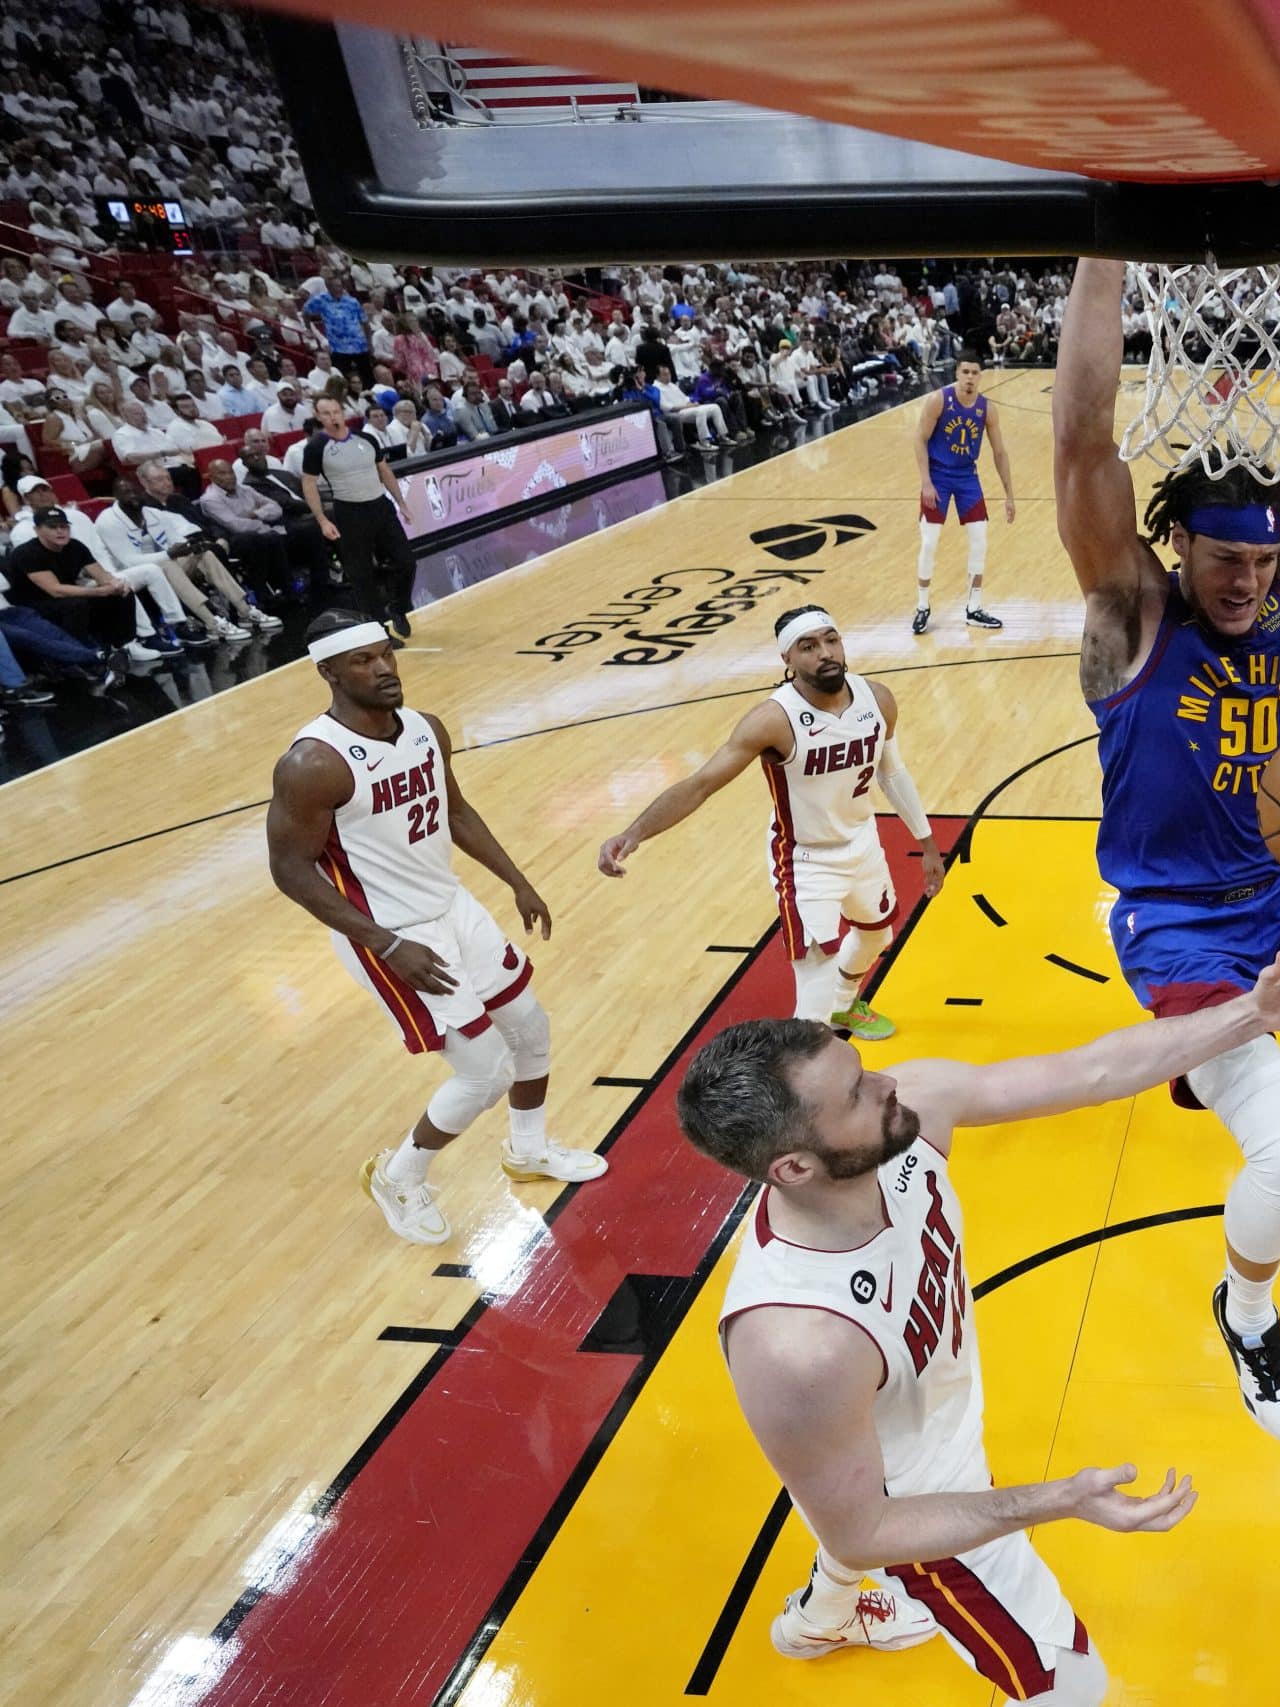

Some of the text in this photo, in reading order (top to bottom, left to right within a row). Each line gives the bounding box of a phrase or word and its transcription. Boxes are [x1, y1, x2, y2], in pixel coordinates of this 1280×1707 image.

[960, 428, 966, 446] 1
[515, 567, 736, 662] Center
[600, 568, 827, 666] Kaseya
[857, 711, 874, 722] UKG
[1176, 656, 1242, 722] MILE
[803, 721, 881, 777] HEAT
[1219, 697, 1280, 757] 50
[371, 746, 436, 815] HEAT
[852, 764, 875, 799] 2
[407, 794, 440, 845] 22
[895, 1154, 919, 1194] UKG
[853, 1275, 874, 1300] 6
[903, 1169, 956, 1379] HEAT
